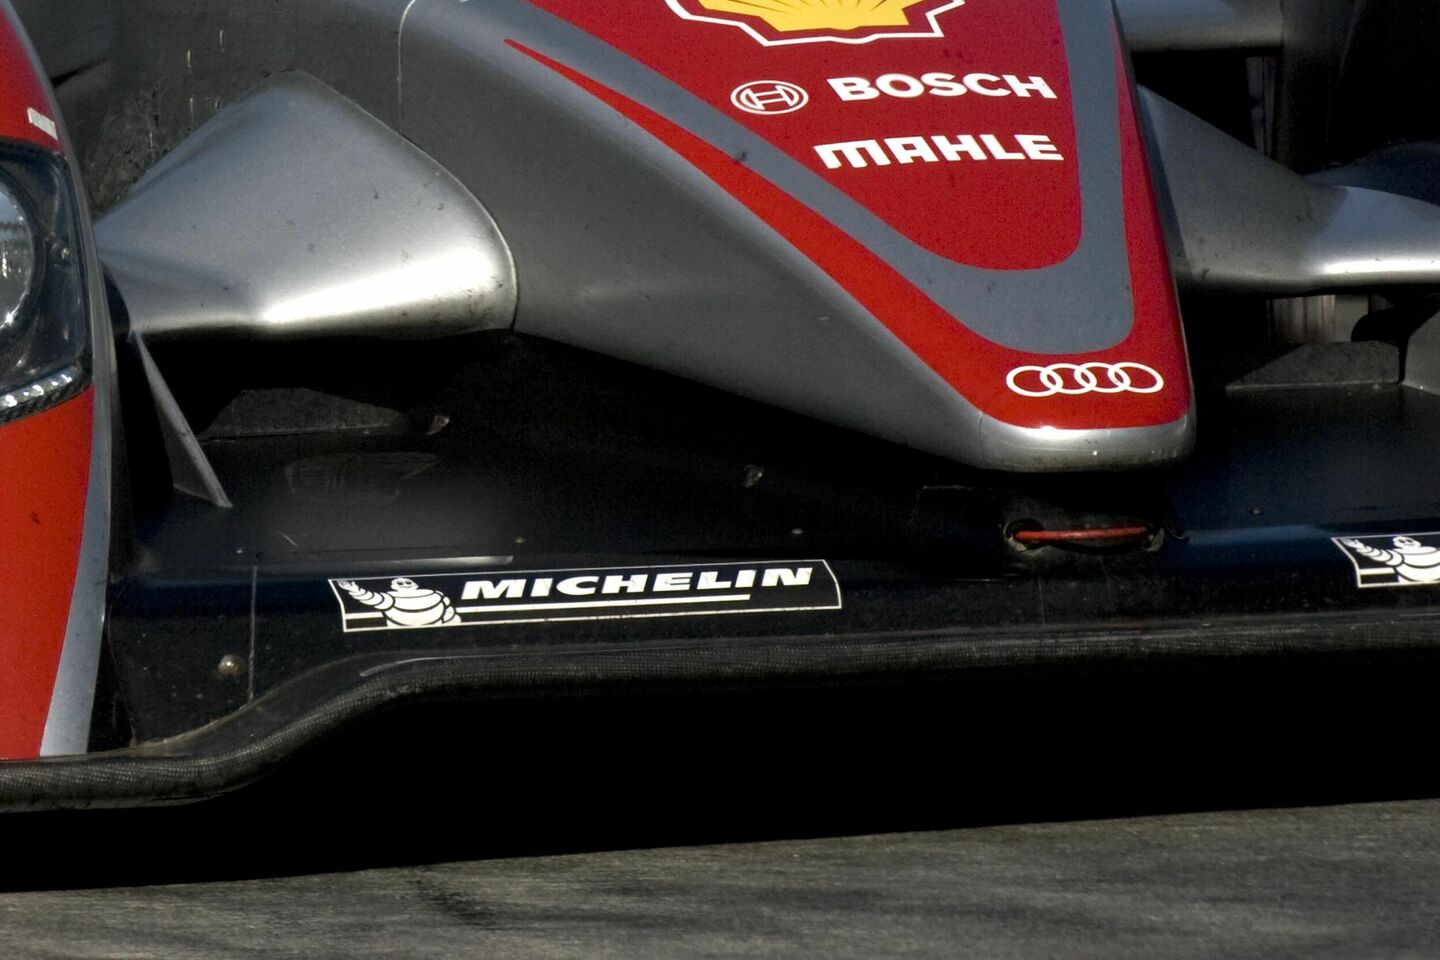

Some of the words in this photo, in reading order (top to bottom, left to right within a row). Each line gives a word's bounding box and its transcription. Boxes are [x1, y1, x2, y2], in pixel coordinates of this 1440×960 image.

[826, 72, 1058, 101] BOSCH
[813, 134, 1064, 169] MAHLE
[461, 568, 813, 600] MICHELIN
